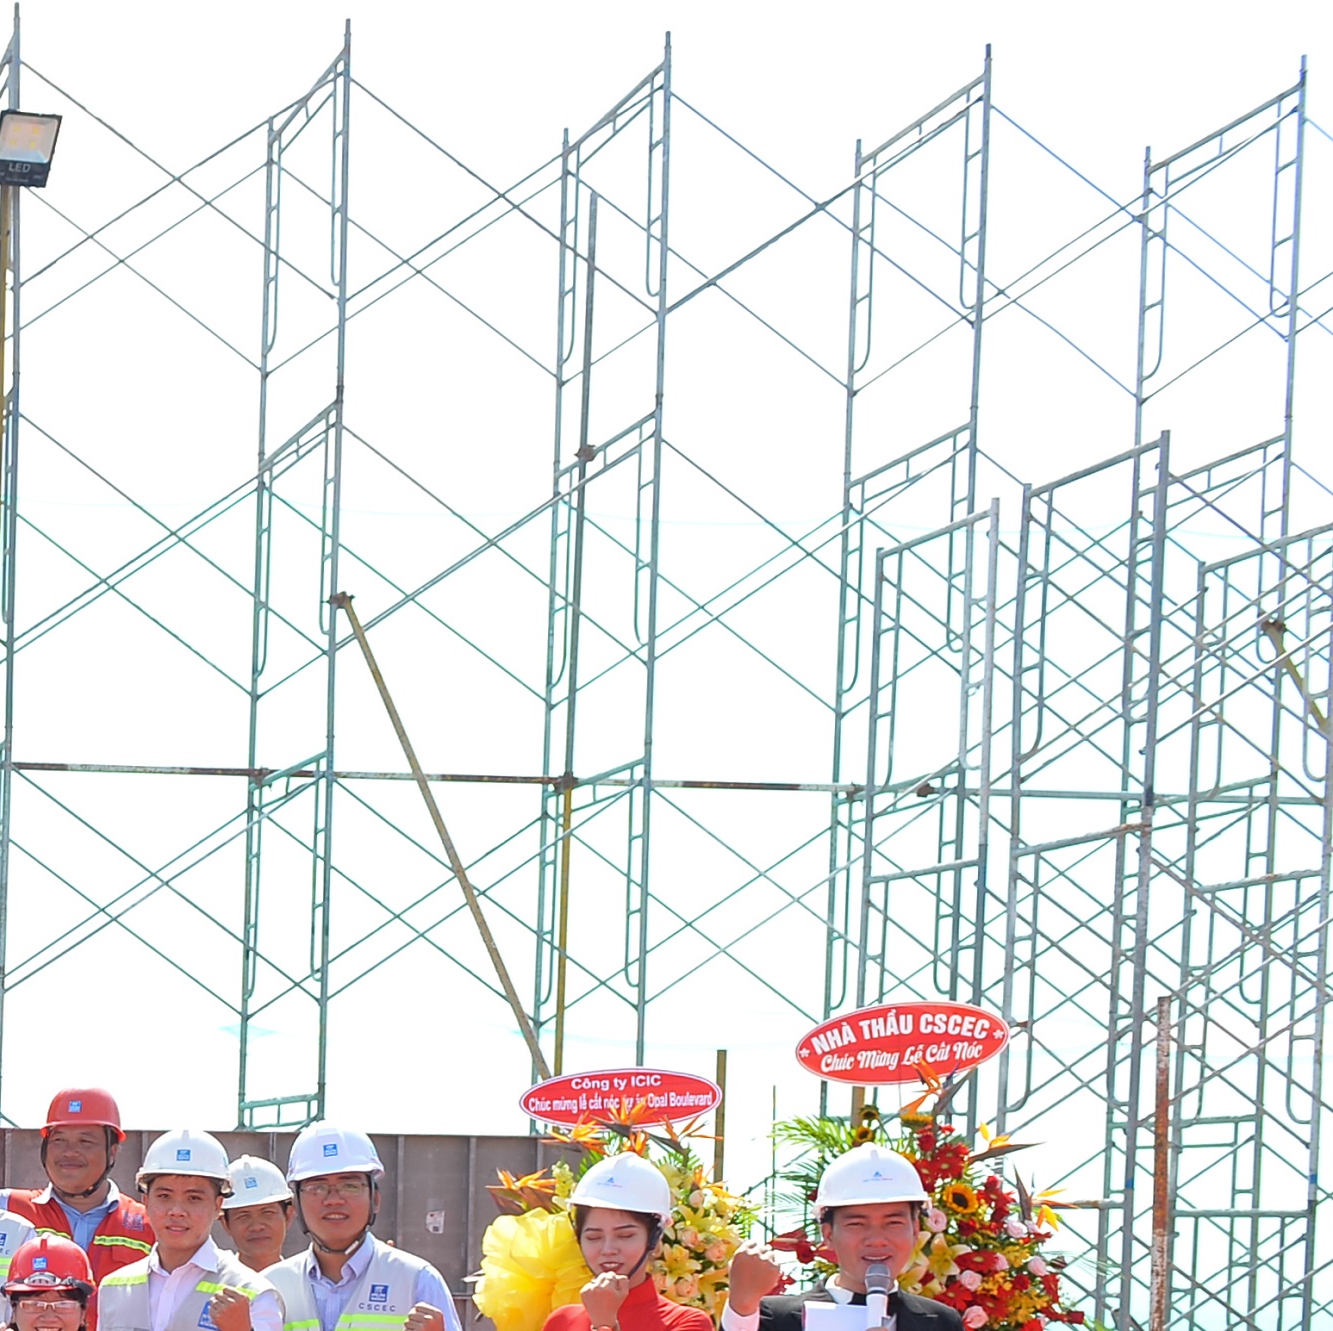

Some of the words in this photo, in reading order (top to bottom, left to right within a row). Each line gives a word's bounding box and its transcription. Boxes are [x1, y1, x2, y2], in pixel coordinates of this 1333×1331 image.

[8, 162, 31, 173] LED
[811, 1022, 857, 1055] NHÀ
[920, 1014, 990, 1039] CSCEC
[820, 1054, 854, 1073] Chúc
[857, 1050, 899, 1071] Mừng
[953, 1041, 983, 1061] Nóc
[571, 1078, 609, 1092] Công
[613, 1078, 627, 1091] ty
[631, 1074, 661, 1087] ICIC
[529, 1096, 551, 1112] Chúc
[553, 1096, 578, 1114] mừng
[648, 1092, 667, 1108] Opal
[669, 1091, 712, 1107] Boulevard
[359, 1302, 396, 1312] CSCEC
